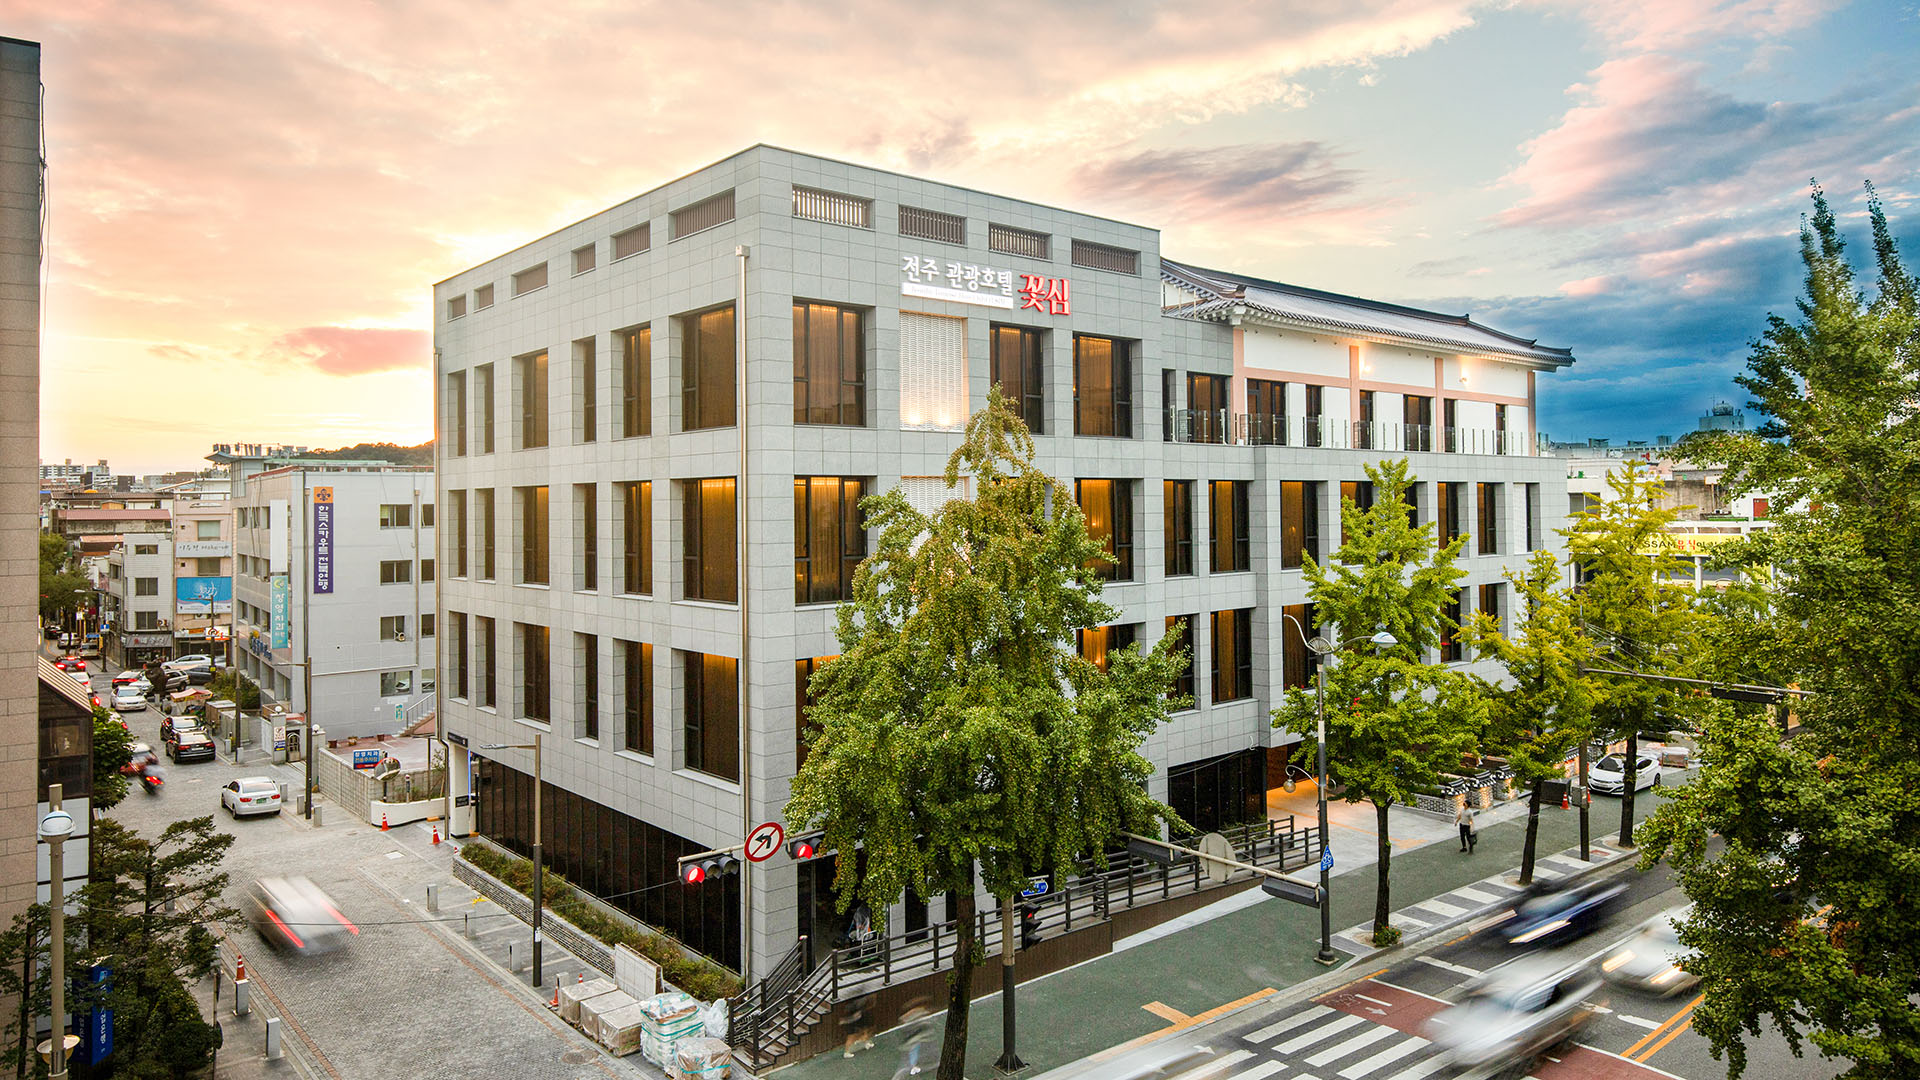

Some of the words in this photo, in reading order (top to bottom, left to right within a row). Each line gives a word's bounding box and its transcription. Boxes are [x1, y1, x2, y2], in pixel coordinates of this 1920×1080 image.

[902, 255, 940, 283] 전주
[945, 262, 1013, 296] 관광호텔
[1017, 273, 1072, 316] 꽃심
